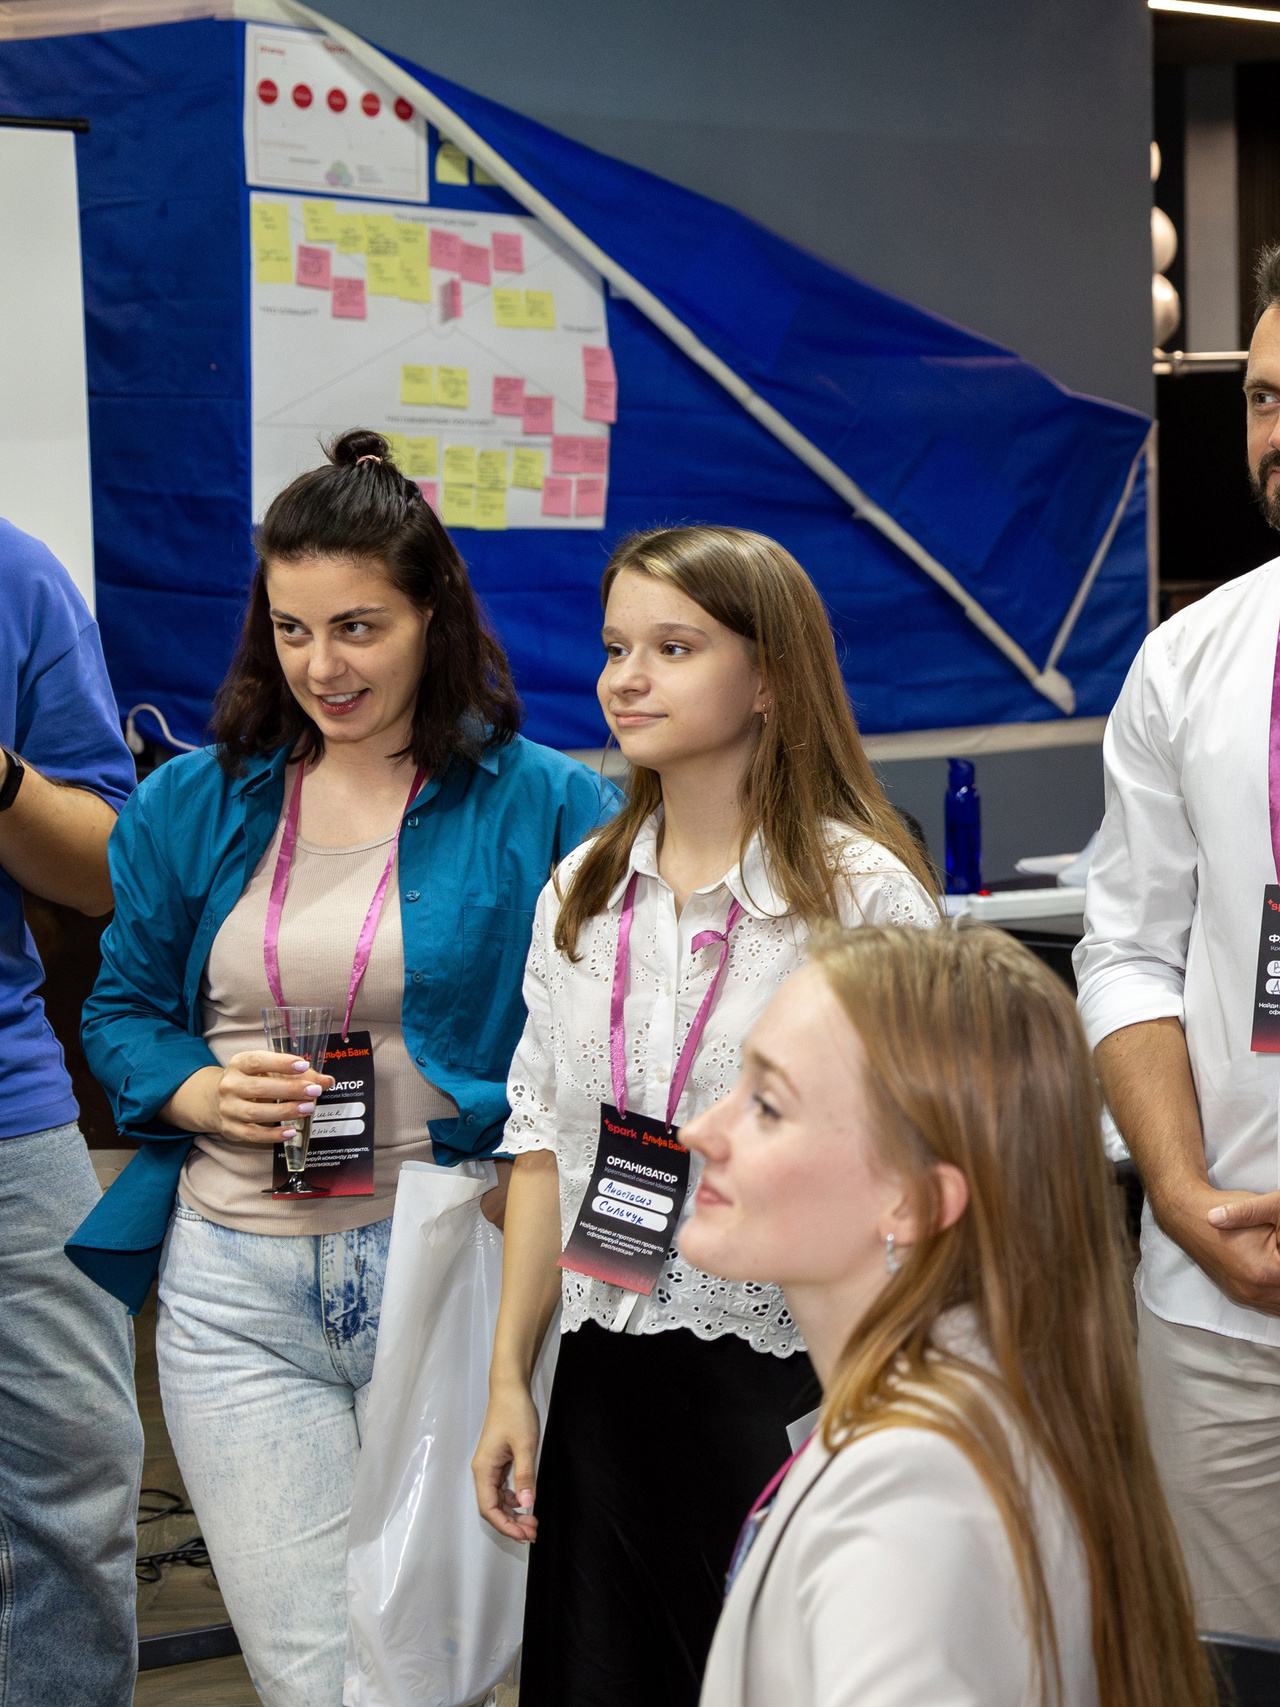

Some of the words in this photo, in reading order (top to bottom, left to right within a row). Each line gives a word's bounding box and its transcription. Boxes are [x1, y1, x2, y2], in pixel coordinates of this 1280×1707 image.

[1258, 1002, 1279, 1010] Найди
[347, 1047, 370, 1057] Банк
[607, 1123, 637, 1139] spark
[642, 1131, 667, 1148] Альфа
[606, 1155, 678, 1184] ОРГАНИЗАТОР
